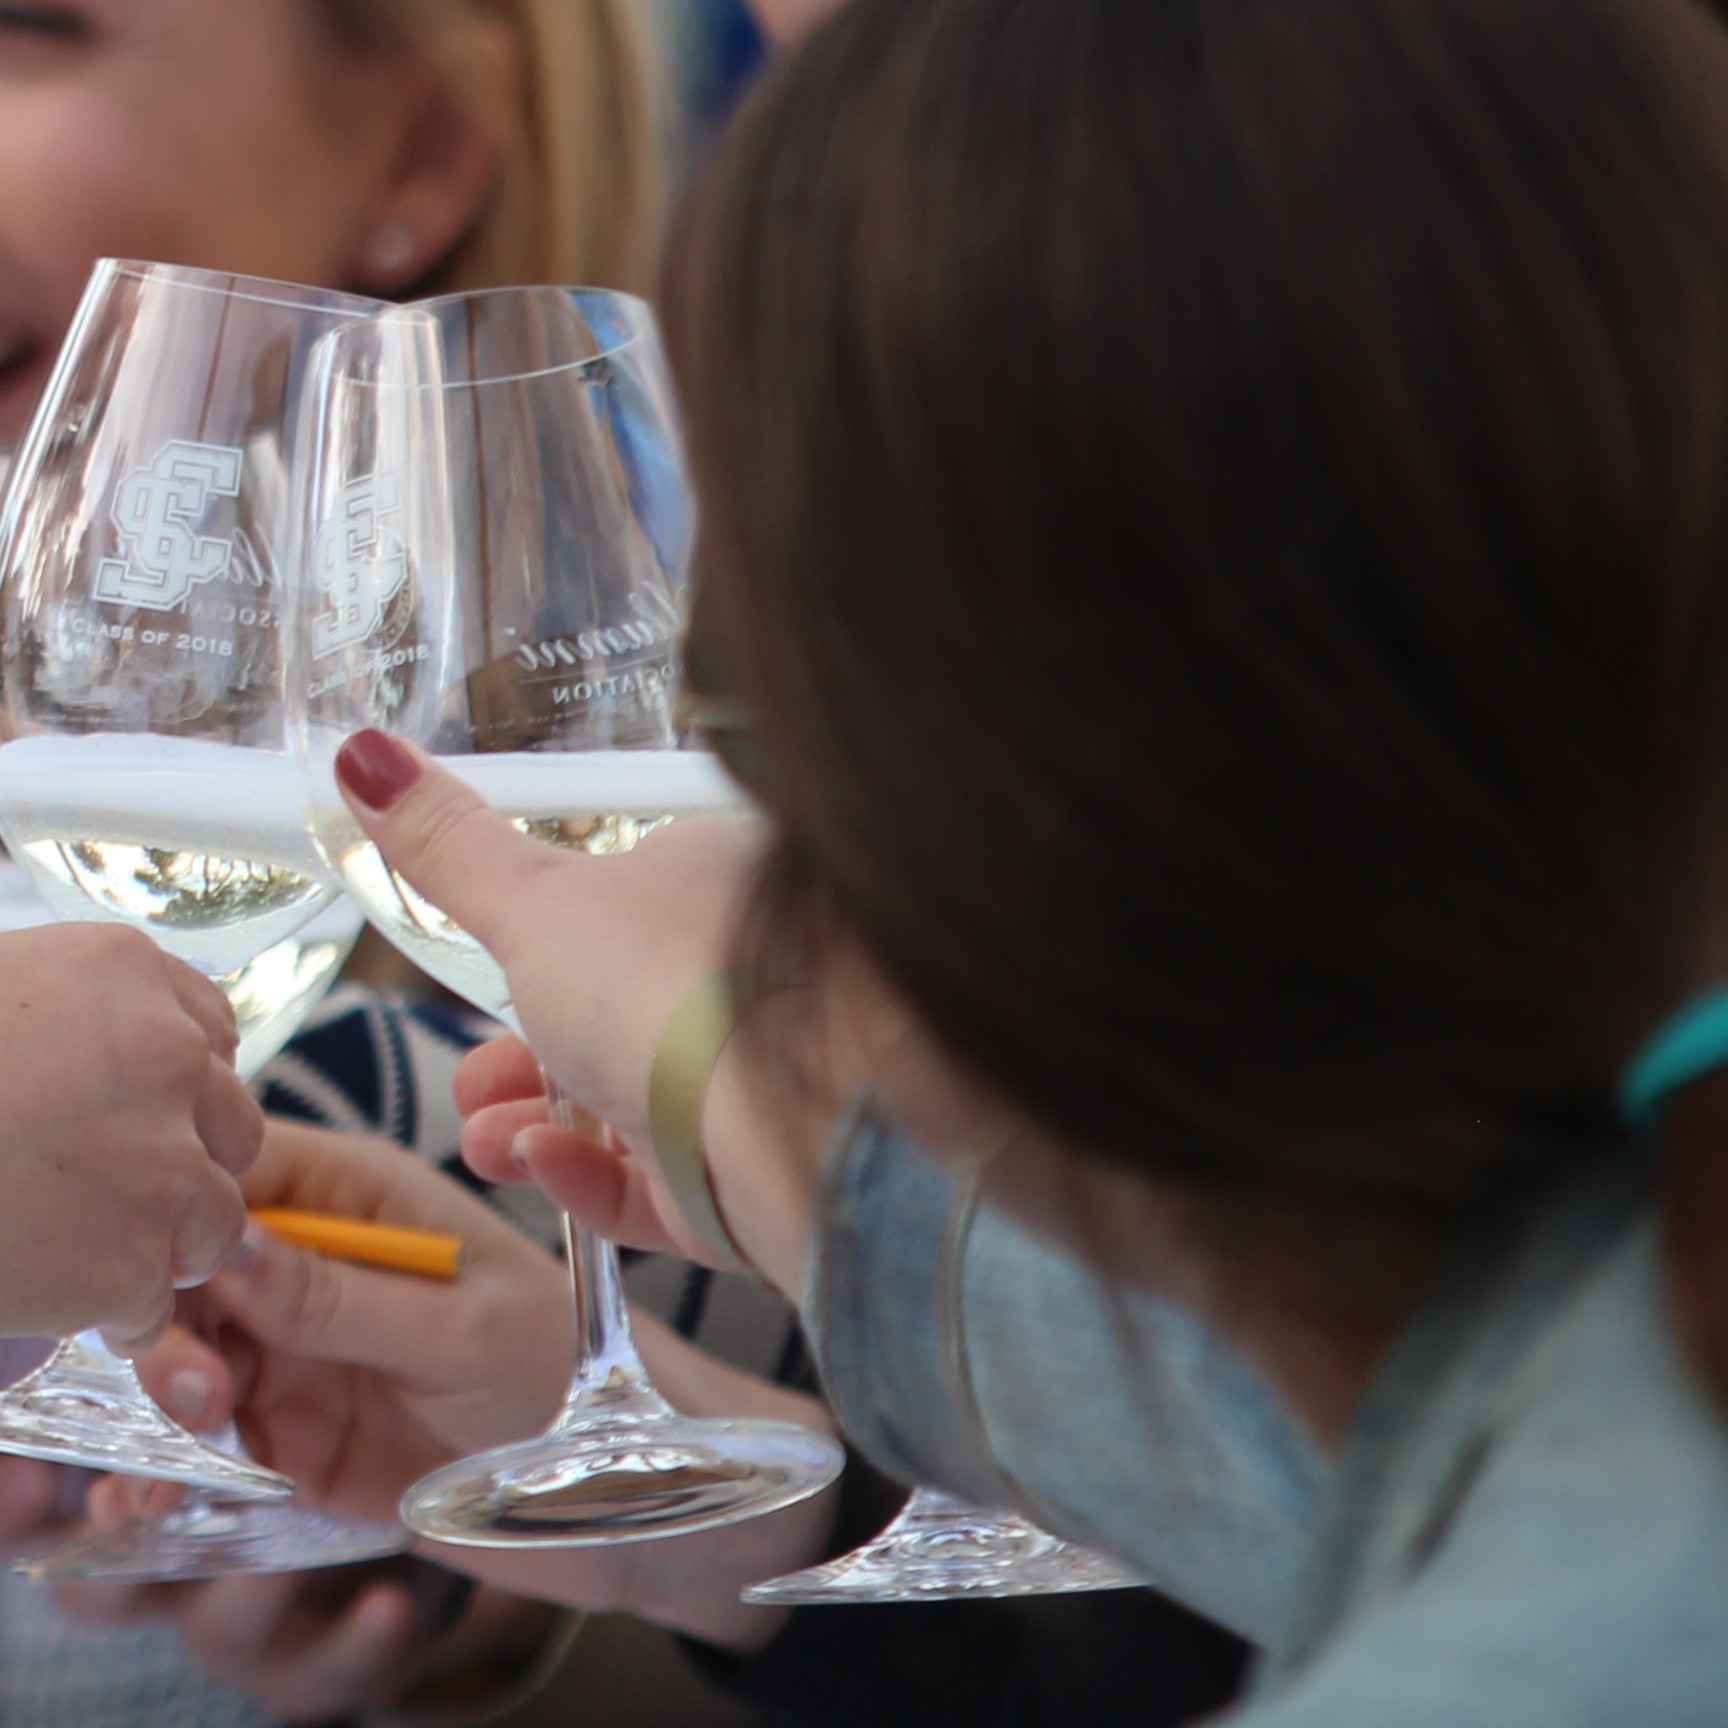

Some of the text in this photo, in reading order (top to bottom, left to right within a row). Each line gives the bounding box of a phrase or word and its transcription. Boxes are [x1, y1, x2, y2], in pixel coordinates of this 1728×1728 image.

[72, 619, 234, 656] CLASS OF 2018
[382, 644, 430, 669] 2018
